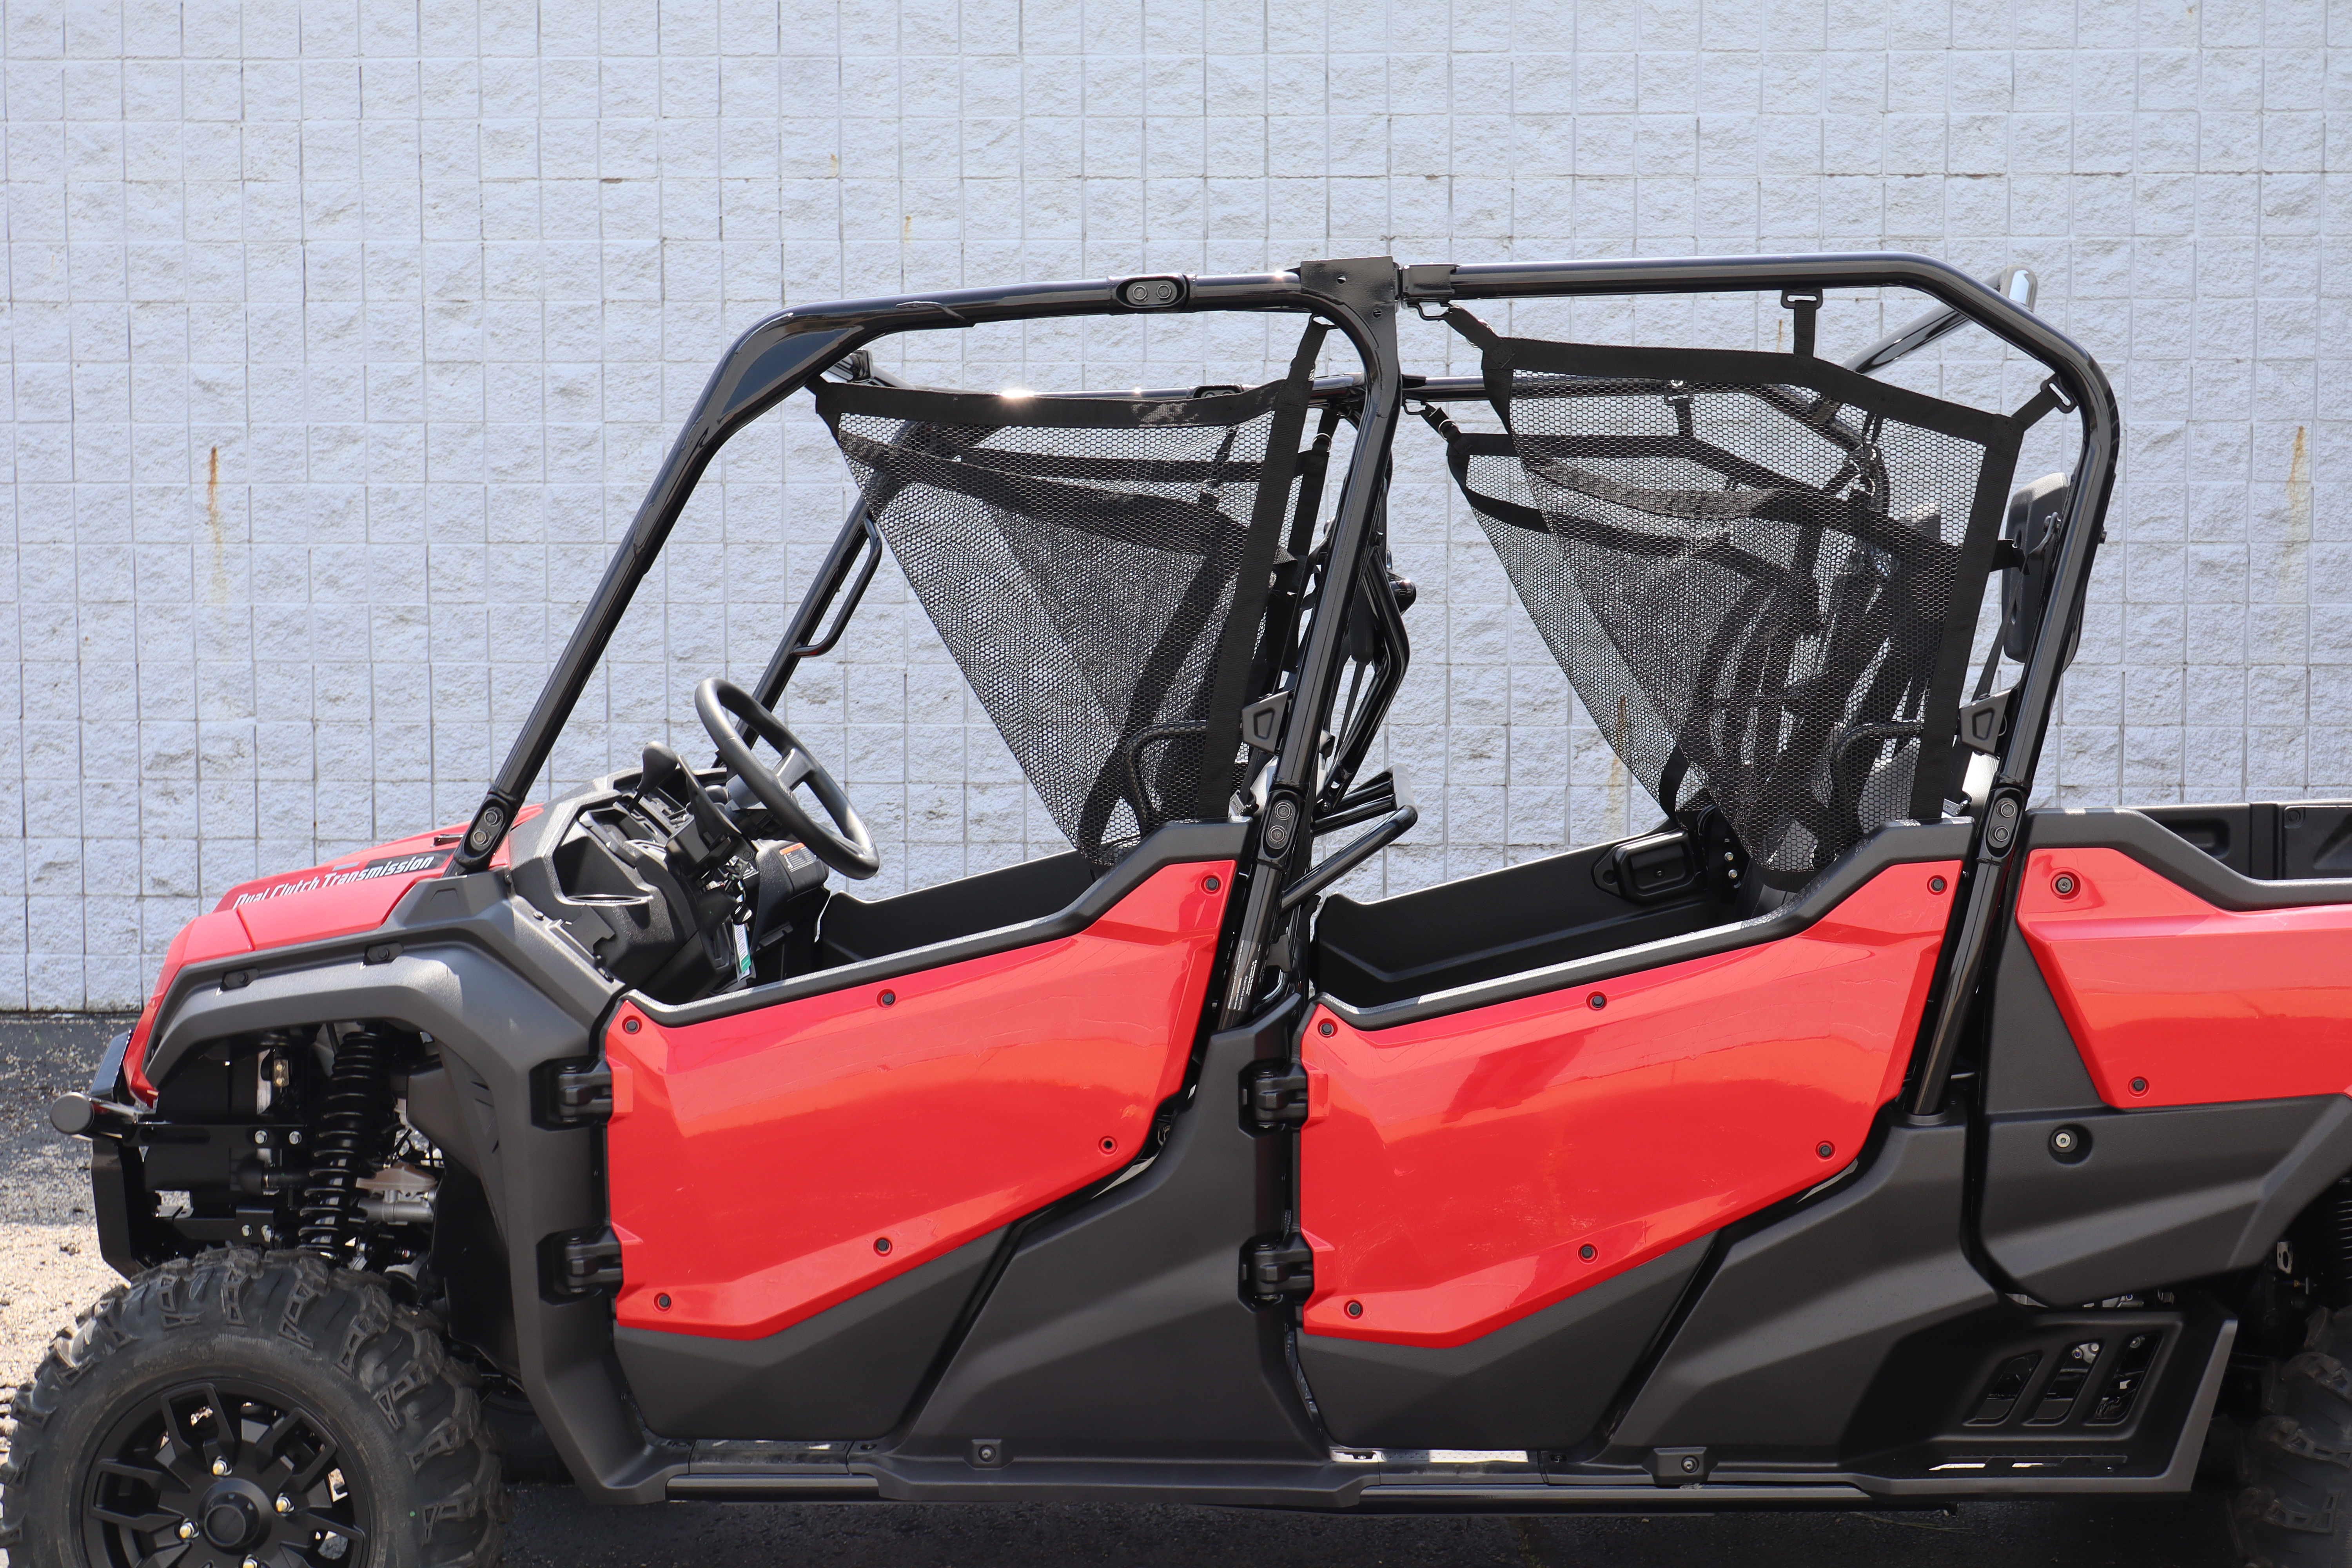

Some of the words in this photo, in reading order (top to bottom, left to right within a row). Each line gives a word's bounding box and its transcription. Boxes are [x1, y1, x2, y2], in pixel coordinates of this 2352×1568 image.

[232, 887, 270, 910] Dual
[270, 876, 320, 899] Clutch
[321, 856, 435, 888] Transmission
